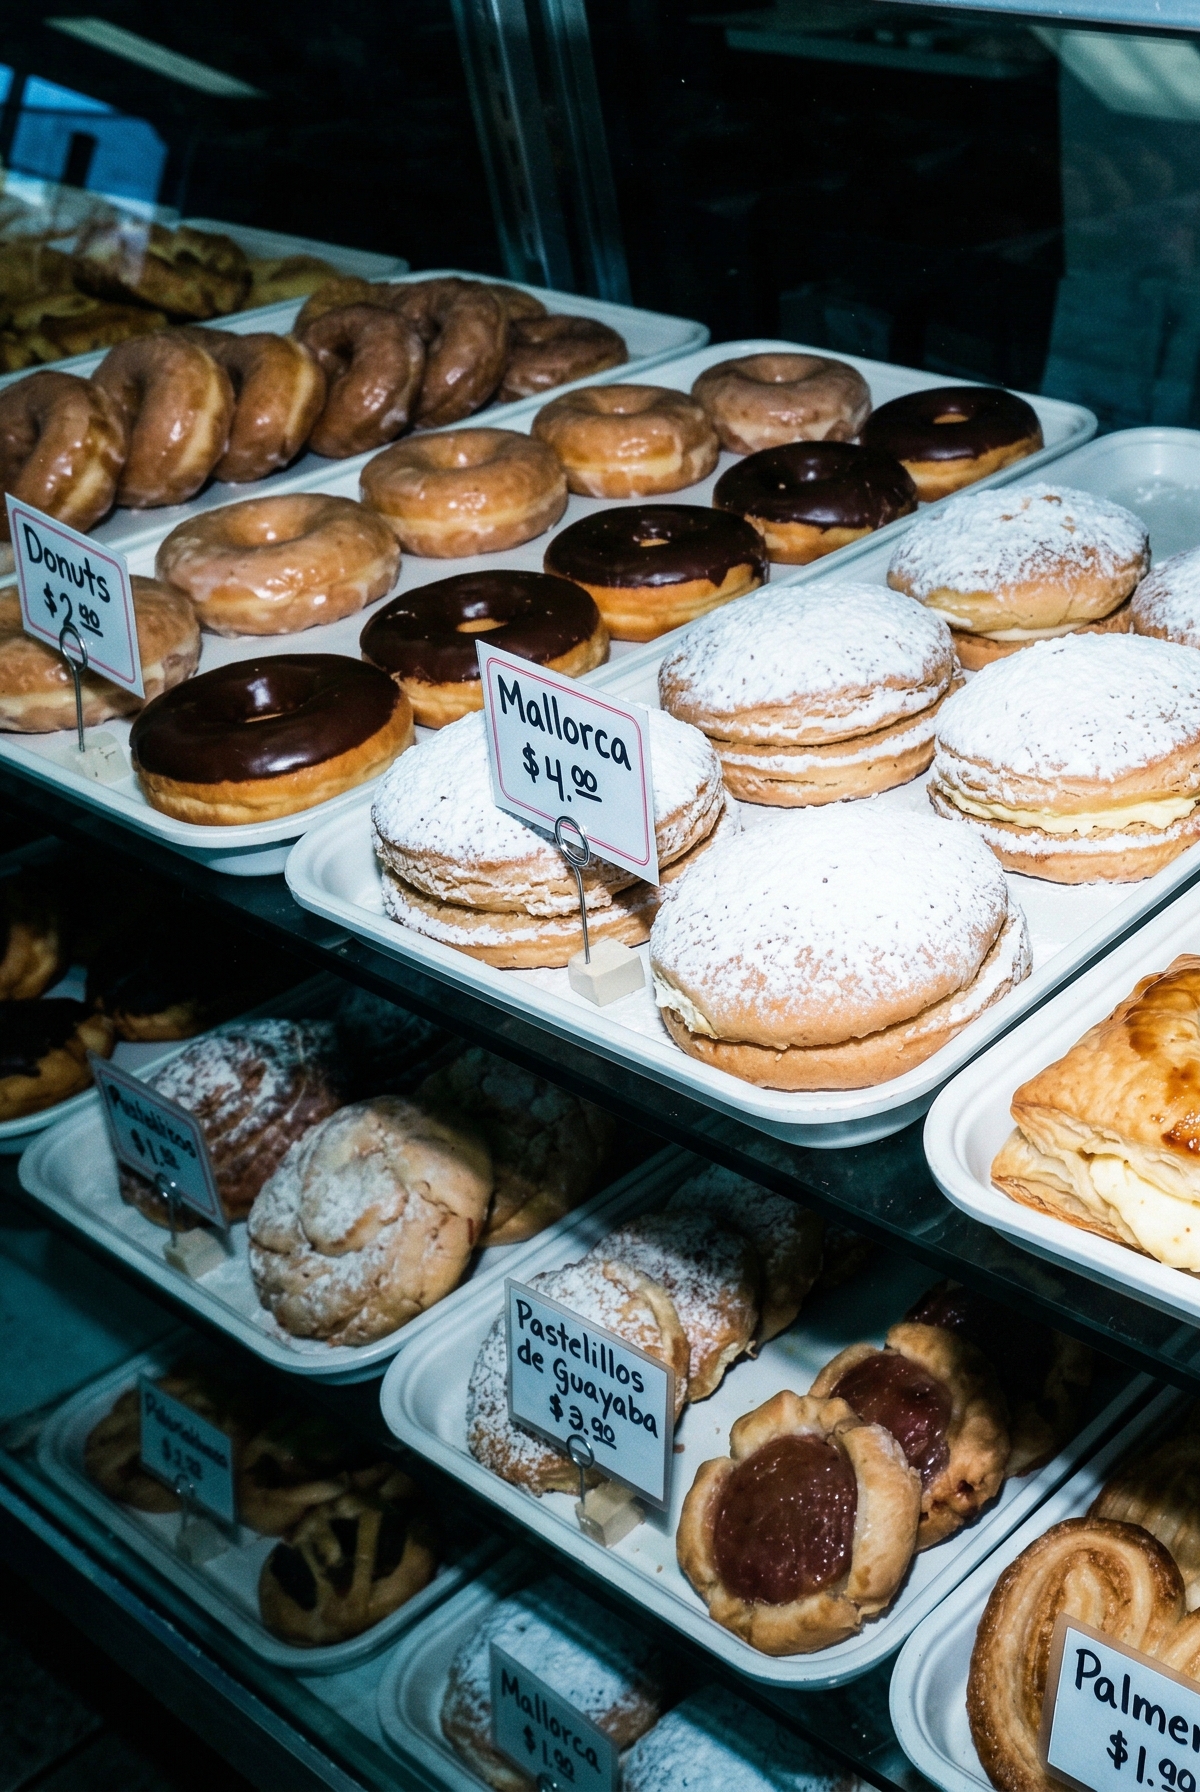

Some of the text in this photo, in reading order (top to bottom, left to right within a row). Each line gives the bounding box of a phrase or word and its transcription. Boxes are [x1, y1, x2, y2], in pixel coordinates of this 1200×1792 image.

[22, 522, 111, 604] Donuts
[497, 674, 632, 771] Mallorca
[522, 742, 603, 803] $4.00
[516, 1298, 645, 1393] Pastelillos
[517, 1338, 545, 1374] de
[501, 1667, 602, 1775] Mallorca
